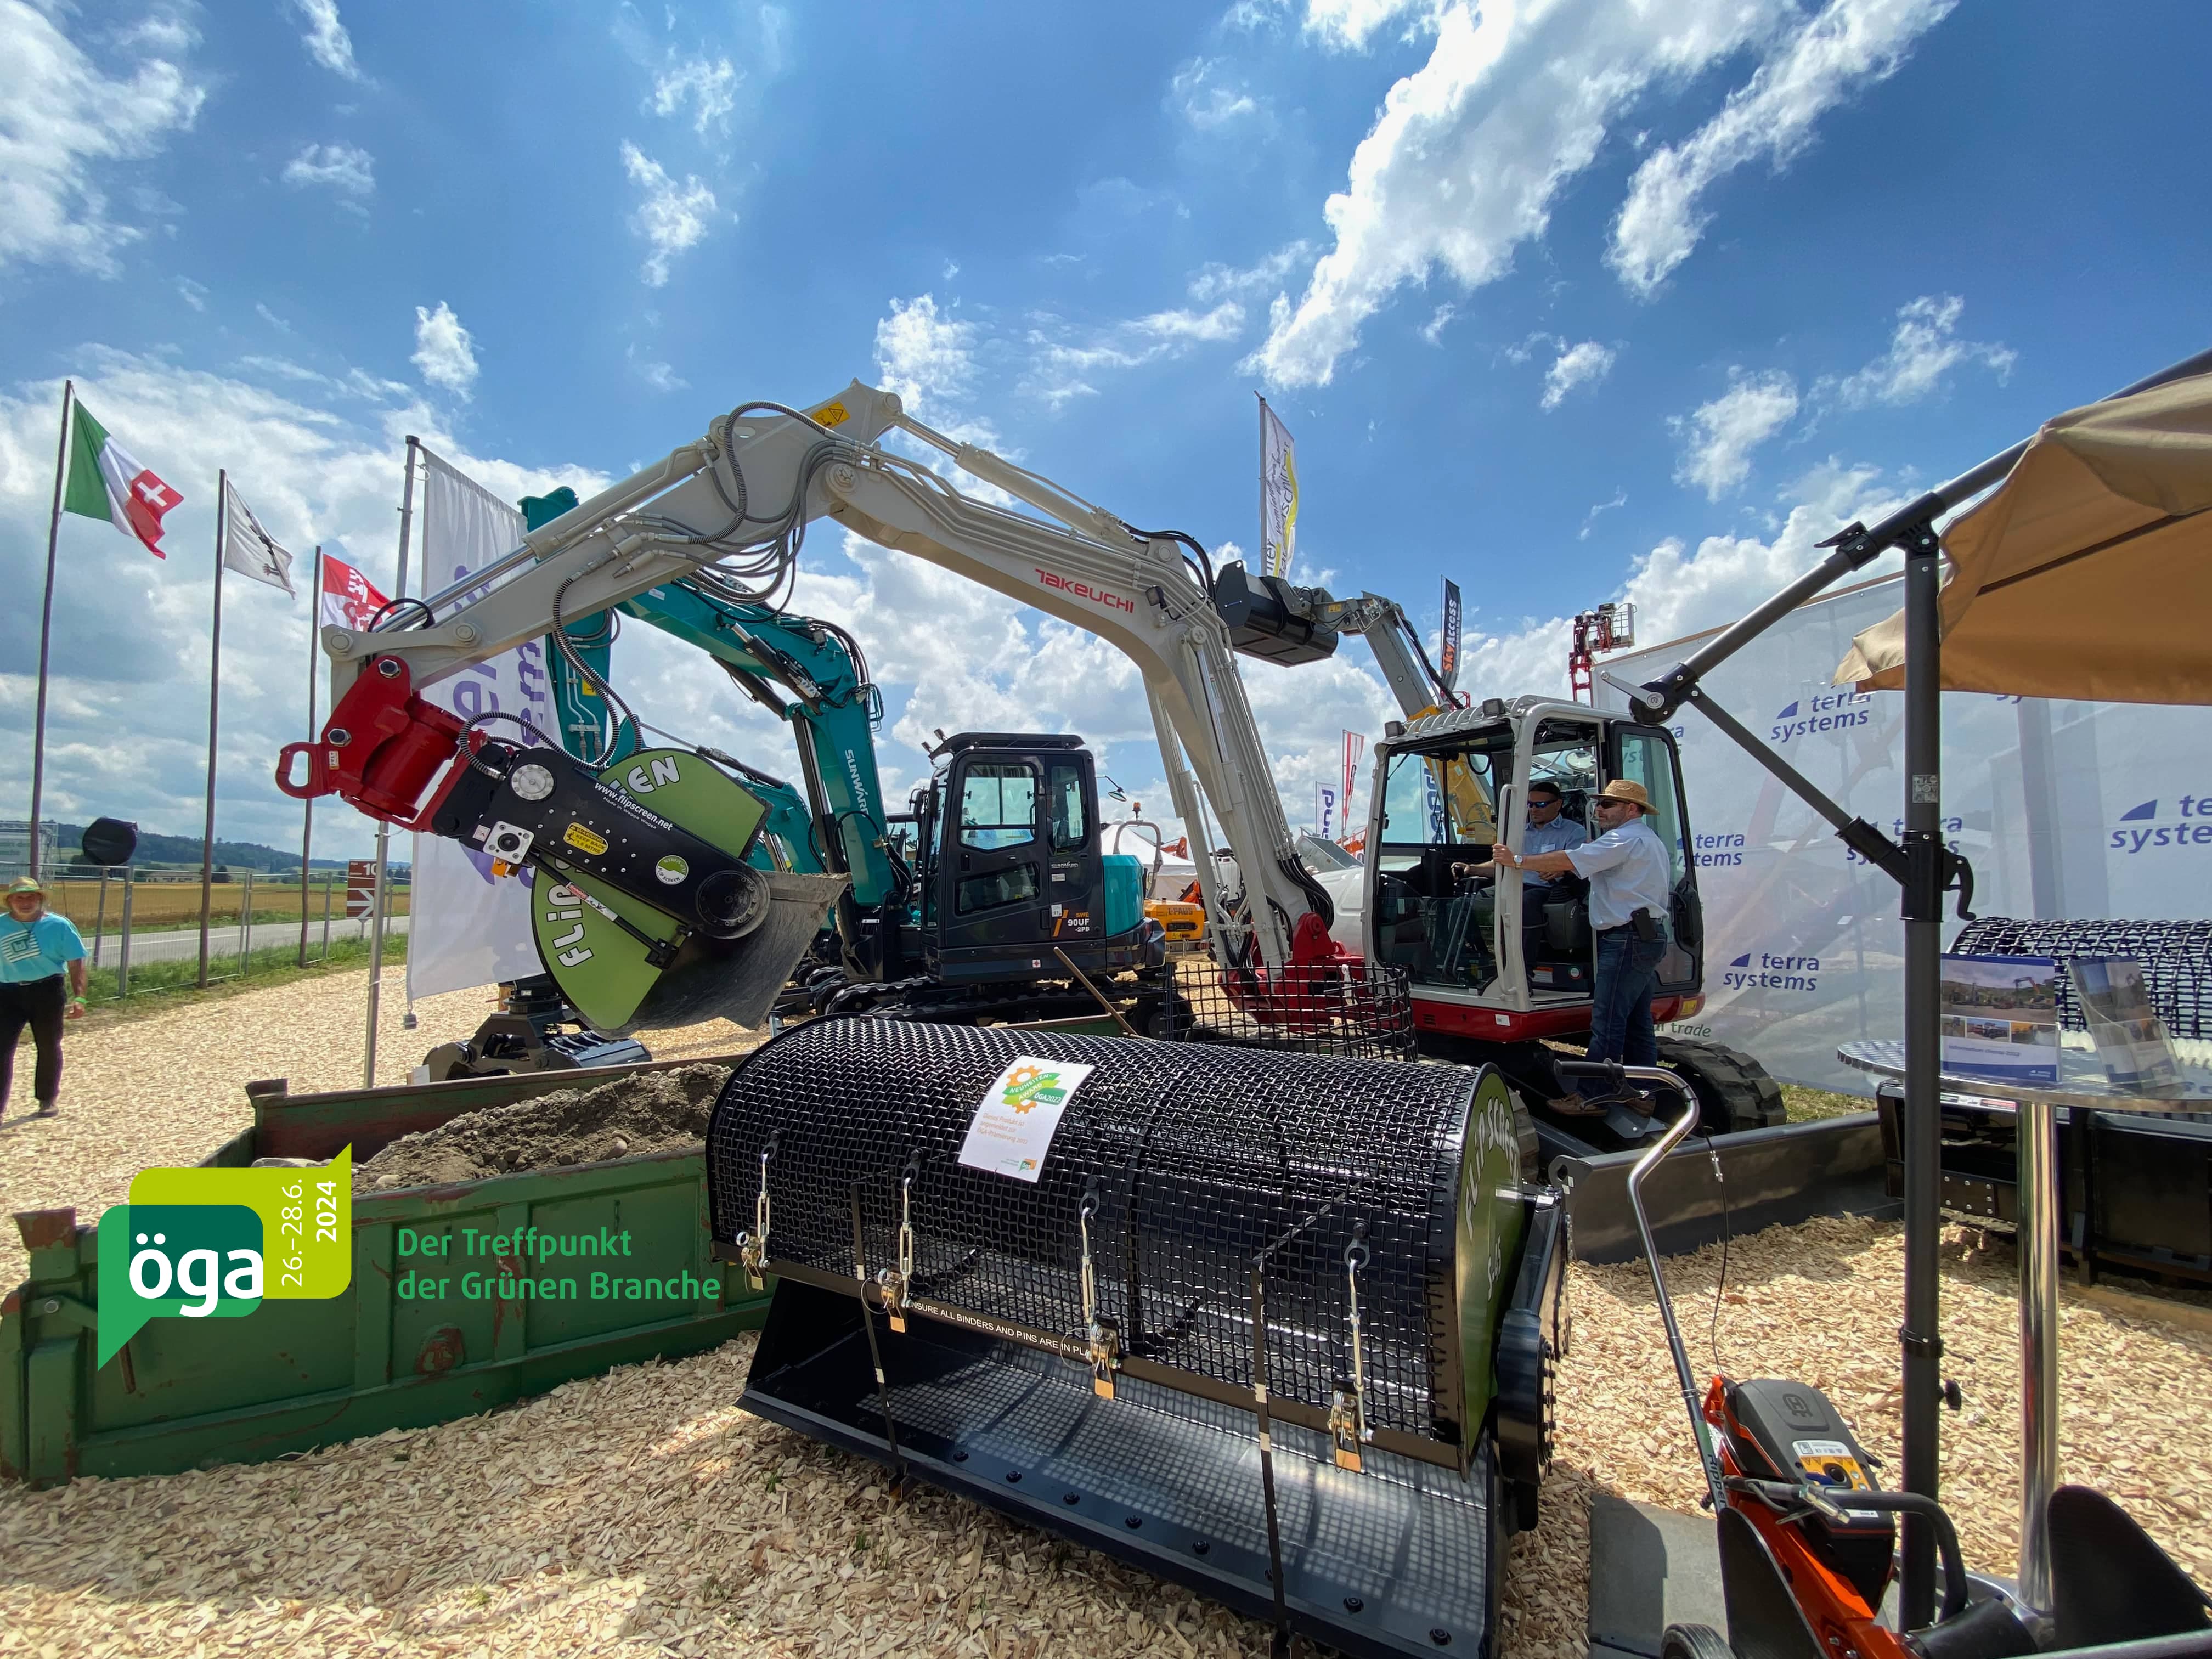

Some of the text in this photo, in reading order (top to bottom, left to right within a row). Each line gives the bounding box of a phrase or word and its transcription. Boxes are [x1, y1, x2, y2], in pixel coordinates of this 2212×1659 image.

[1811, 691, 1871, 713] terra
[1771, 709, 1870, 743] systems
[594, 782, 674, 831] www.flipscreen.net
[1695, 833, 1745, 849] terra
[2110, 822, 2212, 854] syste
[1068, 918, 1090, 927] 90UF
[1762, 953, 1820, 971] terra
[1723, 972, 1818, 991] systems
[1671, 1022, 1712, 1037] trade
[1018, 1082, 1043, 1101] AWARD
[910, 1301, 939, 1315] NSURE
[940, 1310, 955, 1321] ALL
[957, 1313, 994, 1331] BINDERS
[996, 1324, 1014, 1336] AND
[1017, 1329, 1038, 1344] PINS
[1039, 1336, 1059, 1349] ARE
[1060, 1342, 1070, 1353] IN
